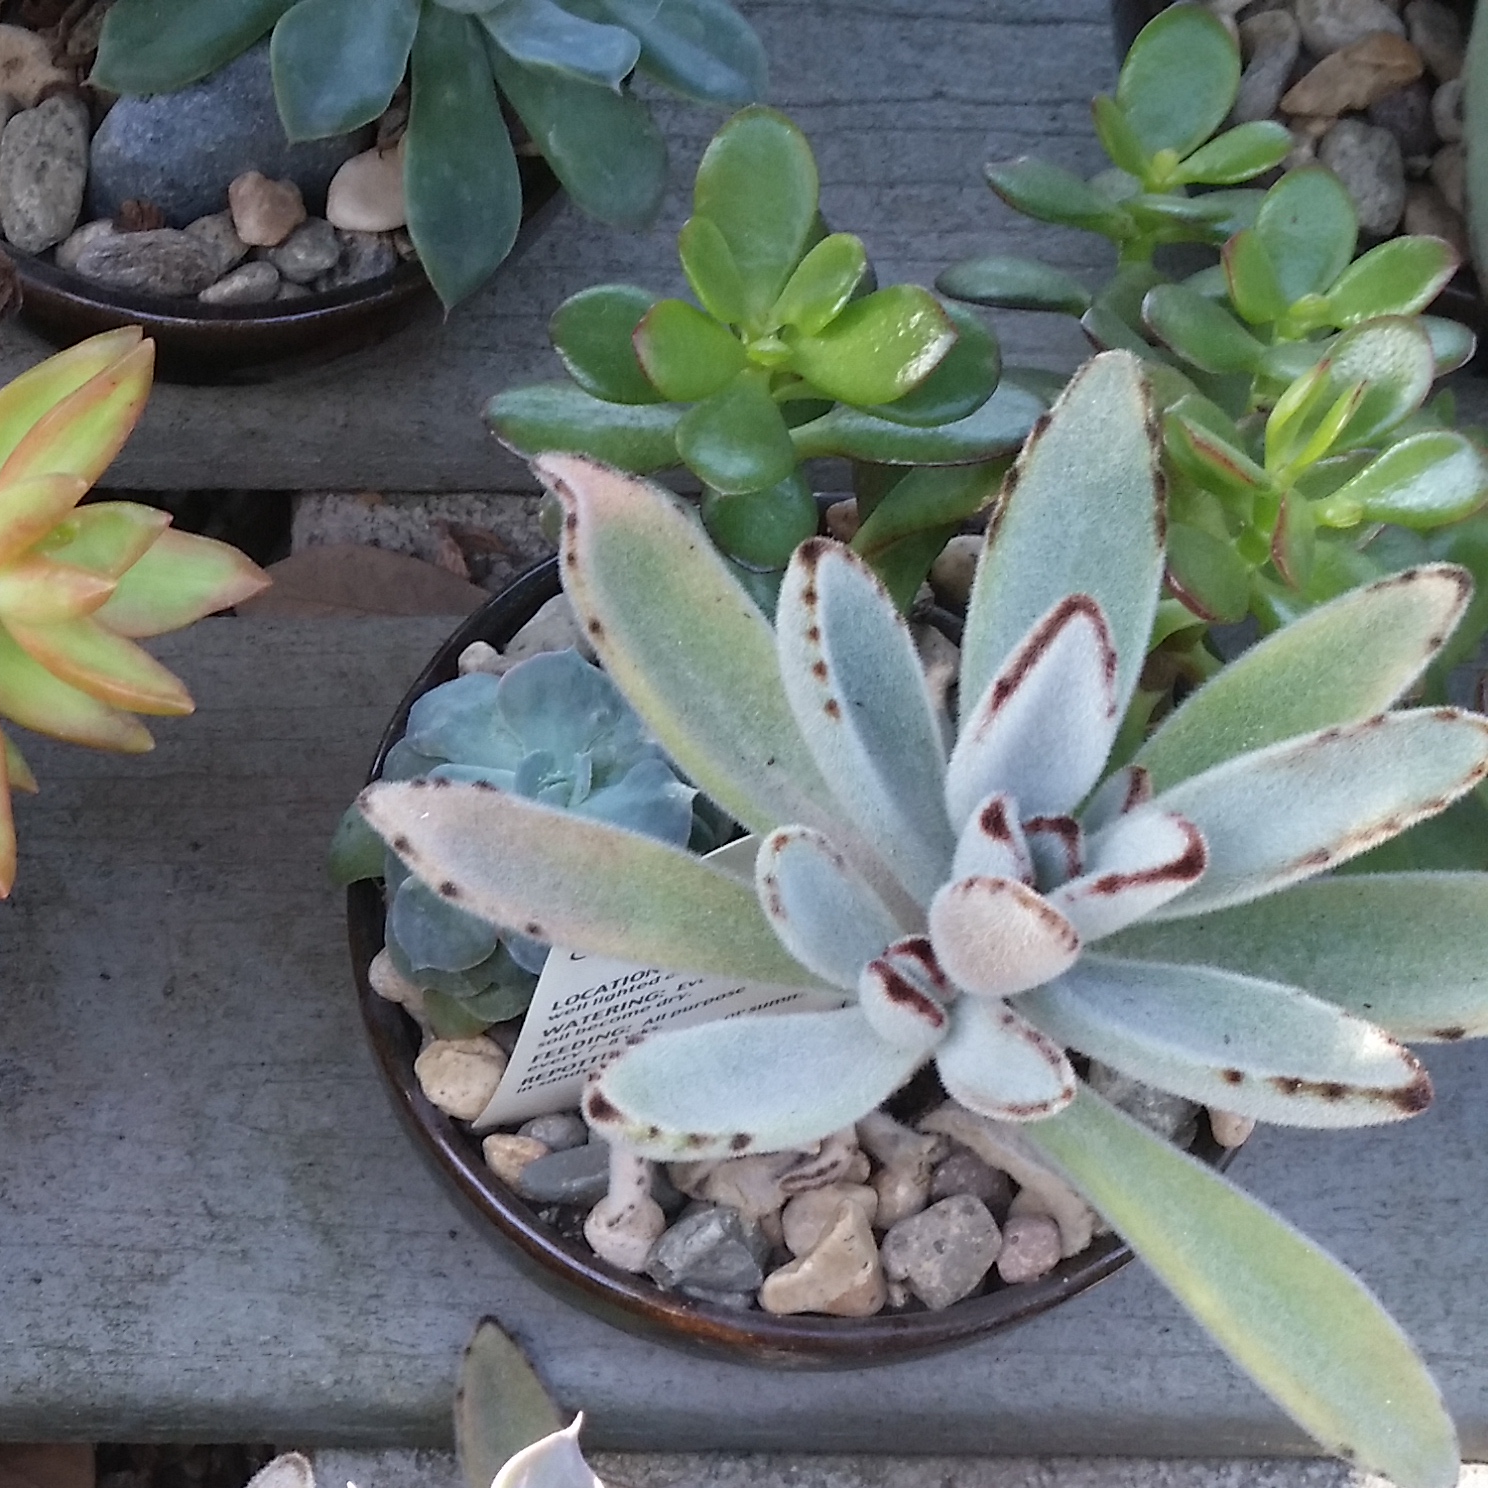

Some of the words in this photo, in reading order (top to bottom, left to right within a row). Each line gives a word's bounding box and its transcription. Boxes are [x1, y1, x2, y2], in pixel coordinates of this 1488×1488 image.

[549, 1001, 588, 1021] well
[593, 975, 660, 1006] lighted
[551, 969, 659, 1011] LOCATION
[532, 1024, 632, 1064] FEEDING:
[642, 1014, 666, 1027] All
[671, 986, 746, 1018] purpose
[538, 1033, 570, 1049] soil
[575, 1005, 651, 1036] become
[542, 990, 666, 1037] WATERING:
[521, 1052, 607, 1086] REPOTTI
[750, 992, 807, 1012] summ
[527, 1051, 582, 1073] every
[539, 1068, 593, 1087] sandy
